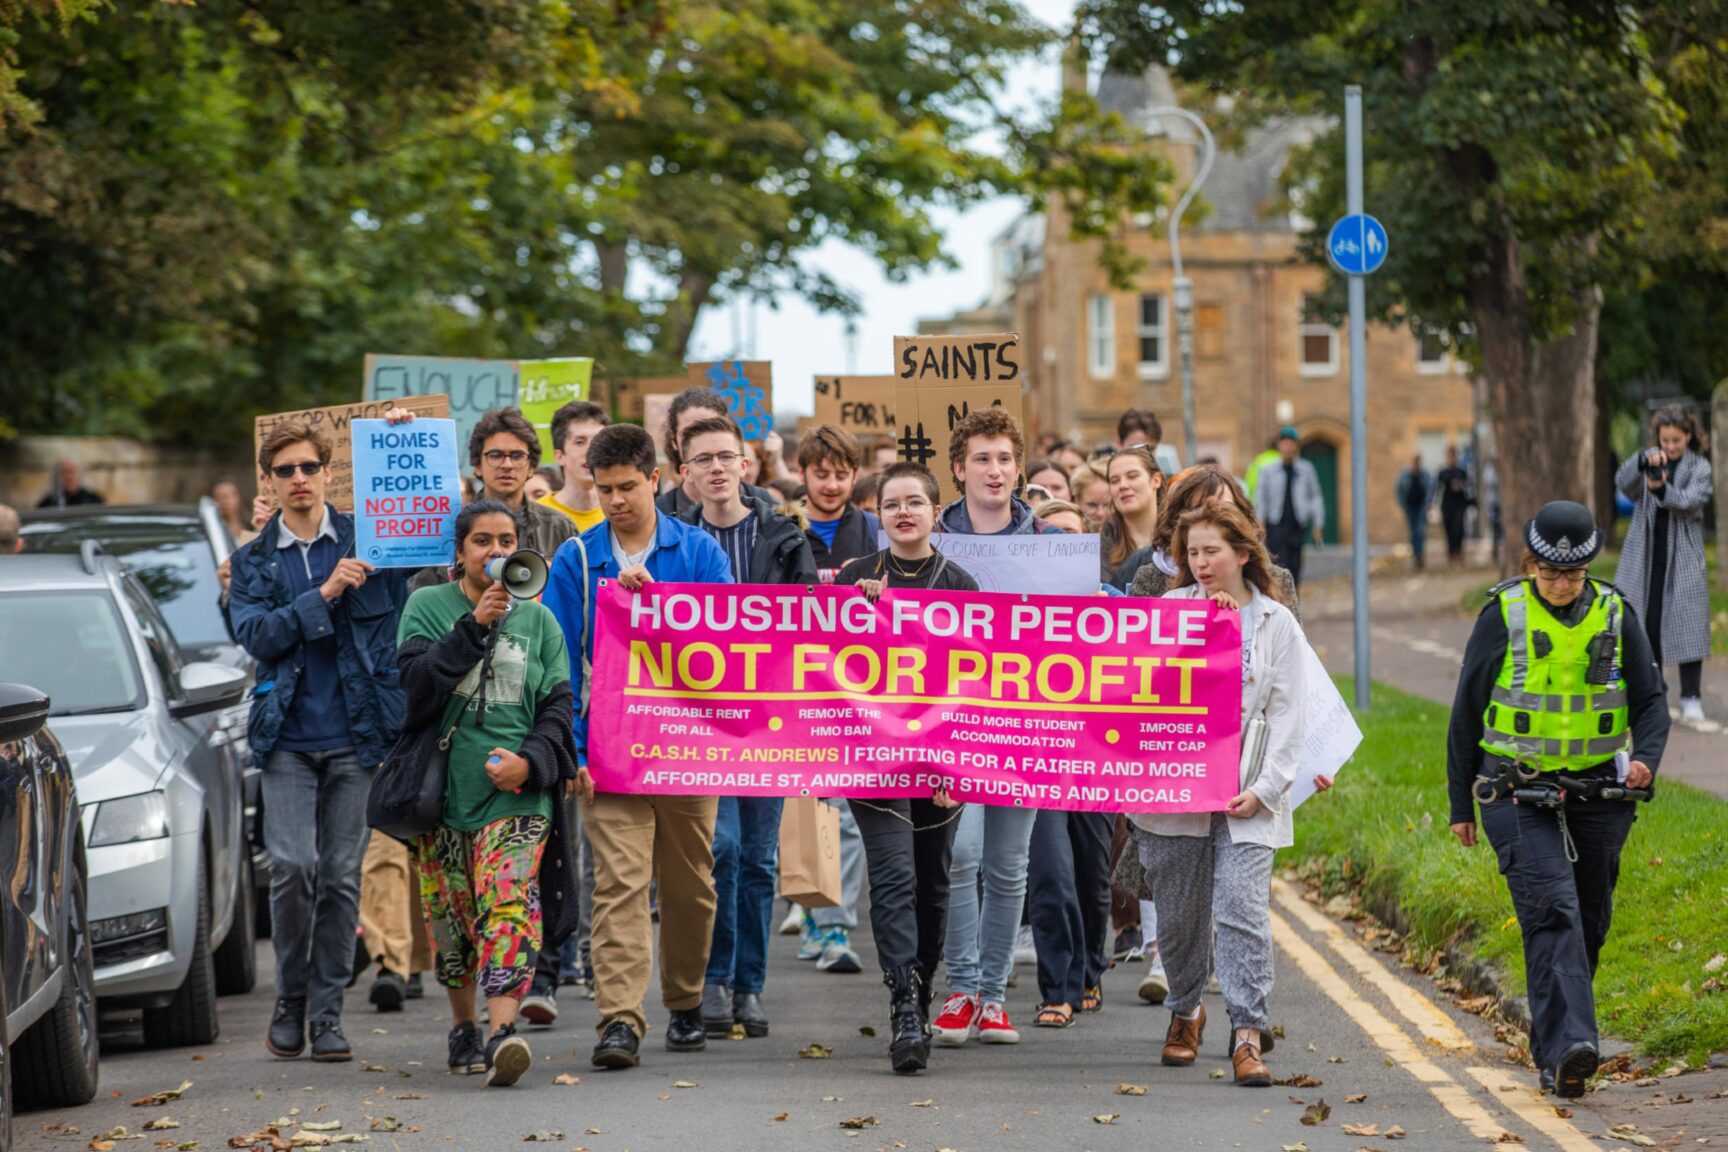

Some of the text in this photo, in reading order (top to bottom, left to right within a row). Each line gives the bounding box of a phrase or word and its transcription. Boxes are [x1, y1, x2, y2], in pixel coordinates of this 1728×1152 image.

[901, 341, 1019, 381] SAINTS
[841, 401, 878, 427] FOR
[371, 432, 439, 449] HOMES
[387, 453, 426, 470] FOR
[372, 475, 443, 492] PEOPLE
[365, 496, 451, 514] NOT FOR
[375, 518, 443, 535] PROFIT
[629, 593, 1207, 645] HOUSING FOR PEOPLE
[628, 640, 1207, 704] NOT FOR PROFIT
[627, 705, 751, 719] AFFORDABLE RENT
[799, 707, 882, 719] REMOVE THE
[941, 711, 1085, 730] BUILD MORE STUDENT
[660, 724, 714, 736] FOR ALL
[811, 725, 872, 736] HMO BAN
[1140, 723, 1206, 733] IMPOSE A
[951, 730, 1075, 748] ACCOMMODATION
[1140, 741, 1206, 751] RENT CAP
[630, 743, 701, 760] C.A.S.H.
[706, 747, 734, 761] ST.
[739, 748, 838, 762] ANDREWS
[855, 746, 955, 764] FIGHTING
[961, 752, 998, 768] FOR
[1004, 756, 1016, 770] A
[1023, 758, 1096, 775] FAIRER
[1101, 761, 1144, 776] AND
[1149, 763, 1206, 777] MORE
[643, 771, 1191, 803] AFFORDABLE ST. ANDREWS FOR STUDENTS AND LOCALS
